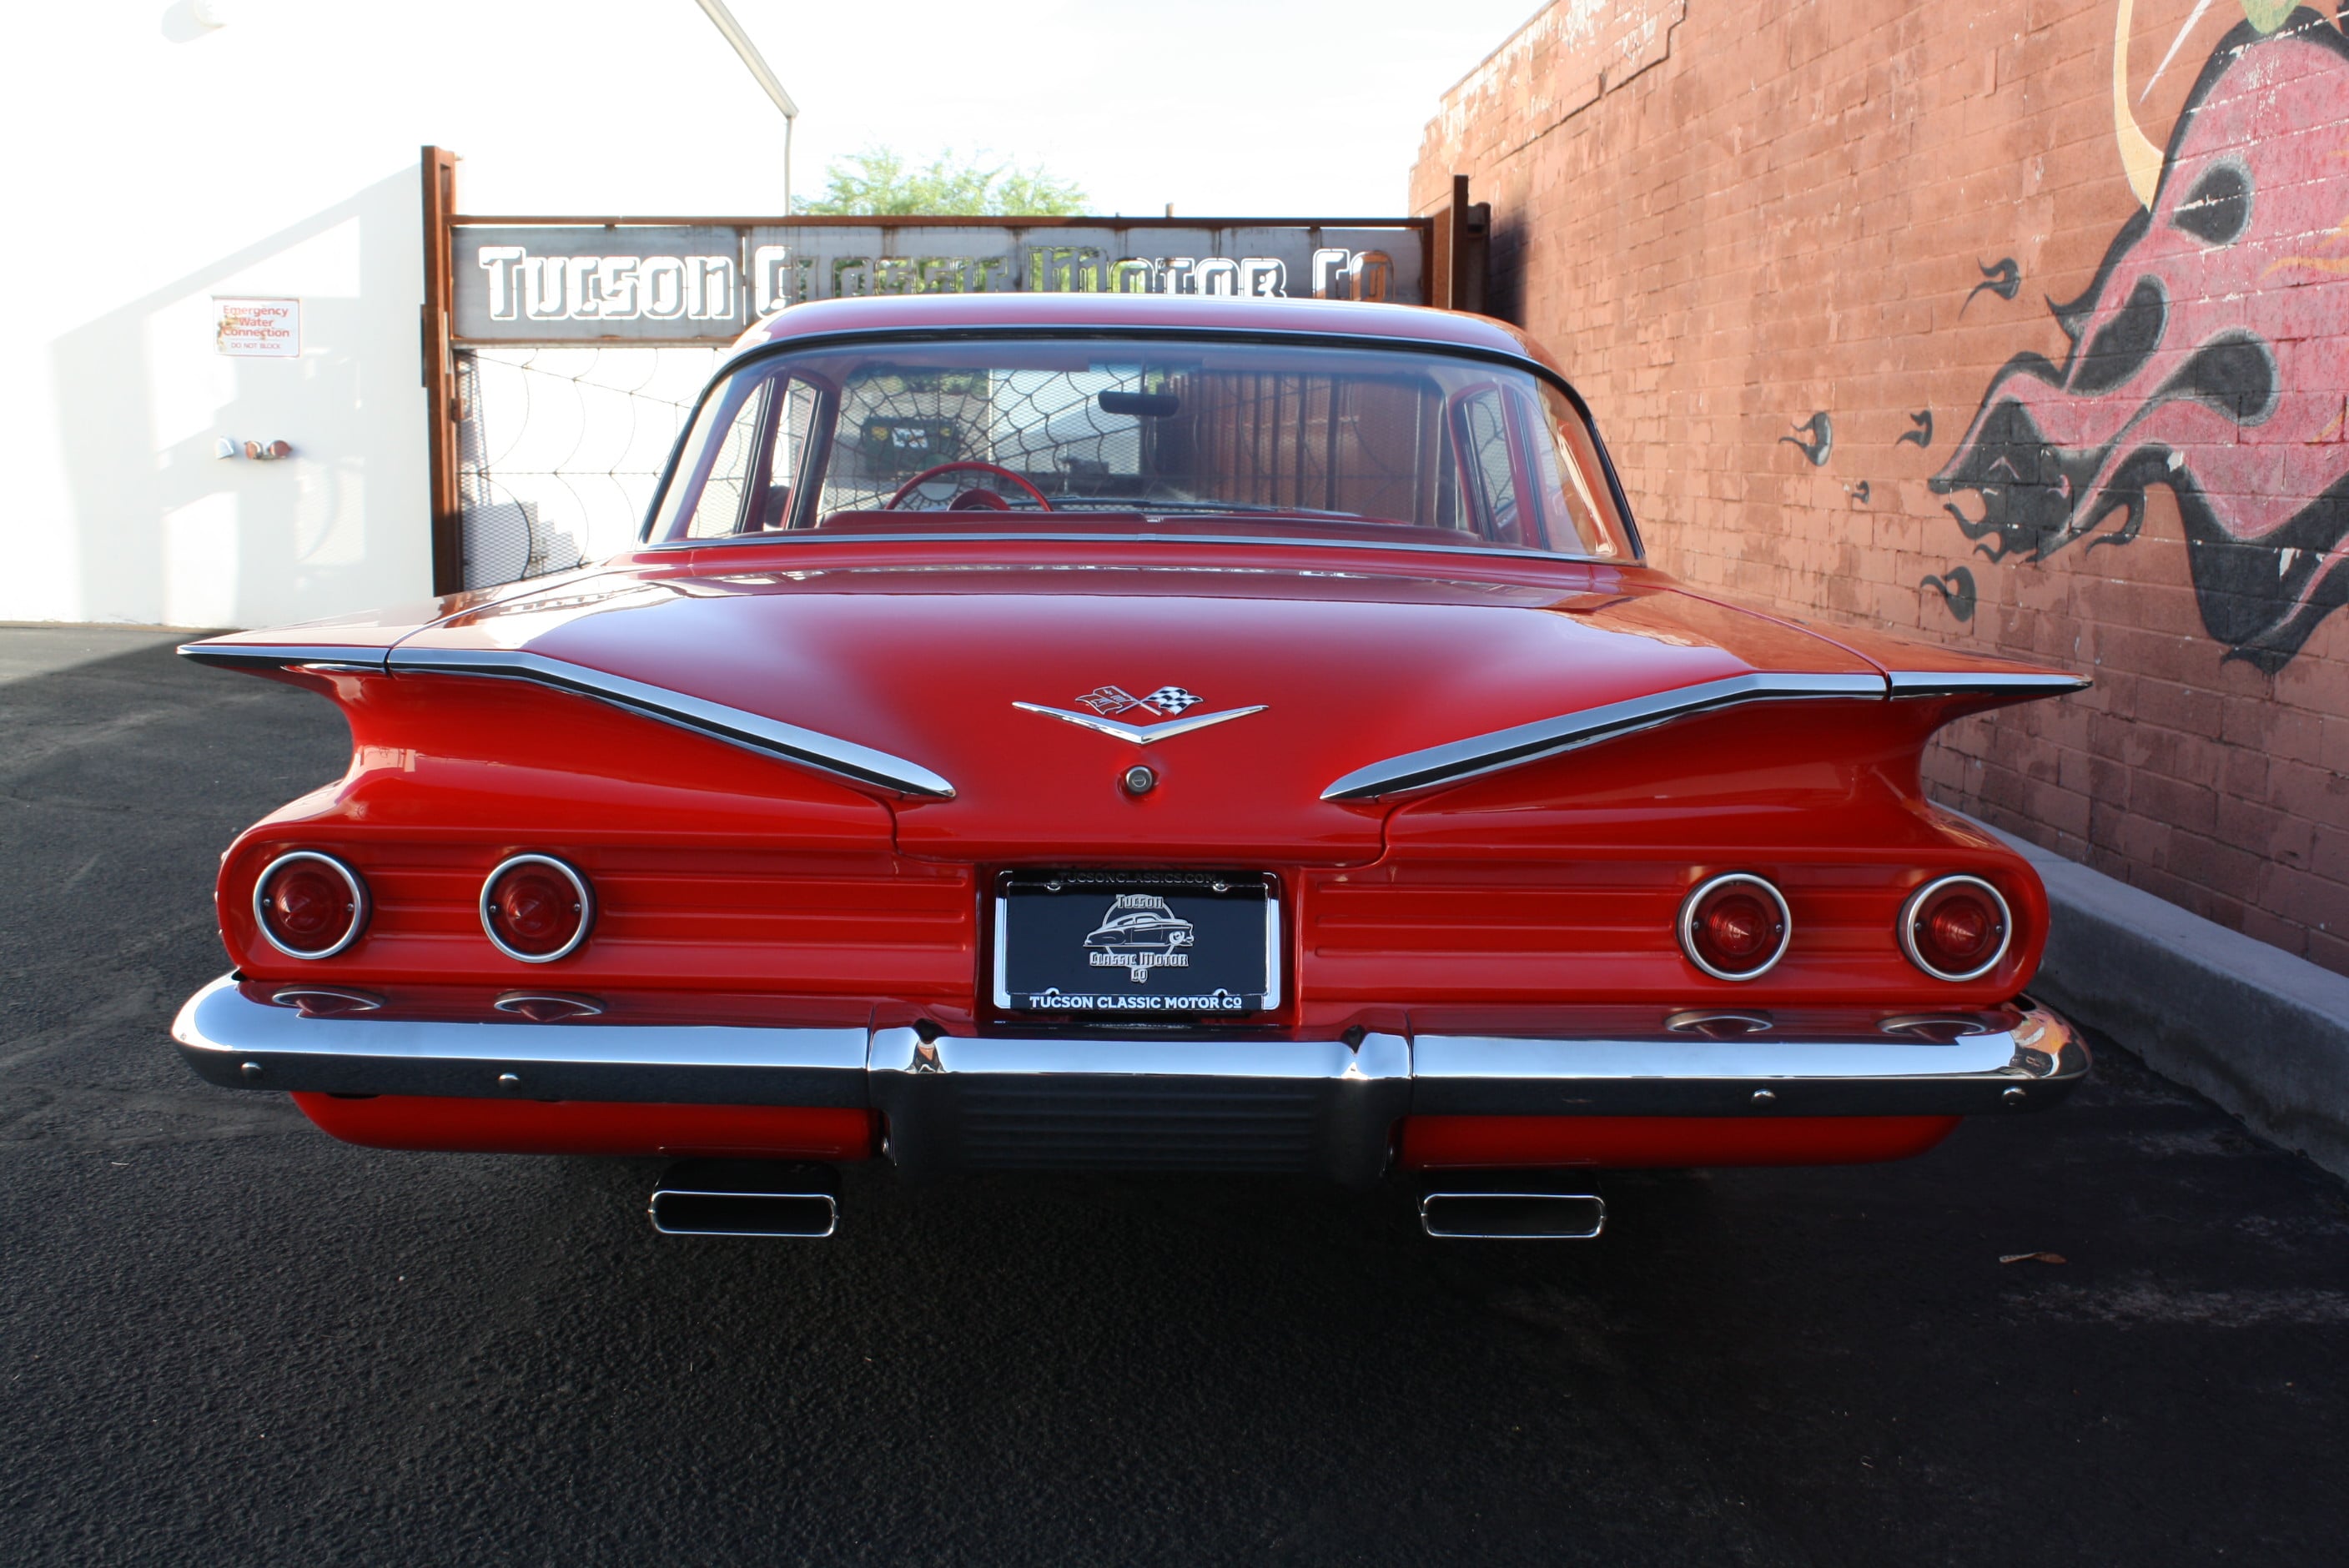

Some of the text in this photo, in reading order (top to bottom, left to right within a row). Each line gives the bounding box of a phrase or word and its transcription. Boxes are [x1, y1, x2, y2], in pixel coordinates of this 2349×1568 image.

[223, 304, 289, 318] Emergency
[239, 317, 274, 327] Water
[222, 326, 289, 338] Connection
[1029, 996, 1094, 1009] TUCSON
[1097, 996, 1161, 1009] CLASSIC
[1164, 996, 1220, 1009] MOTOR
